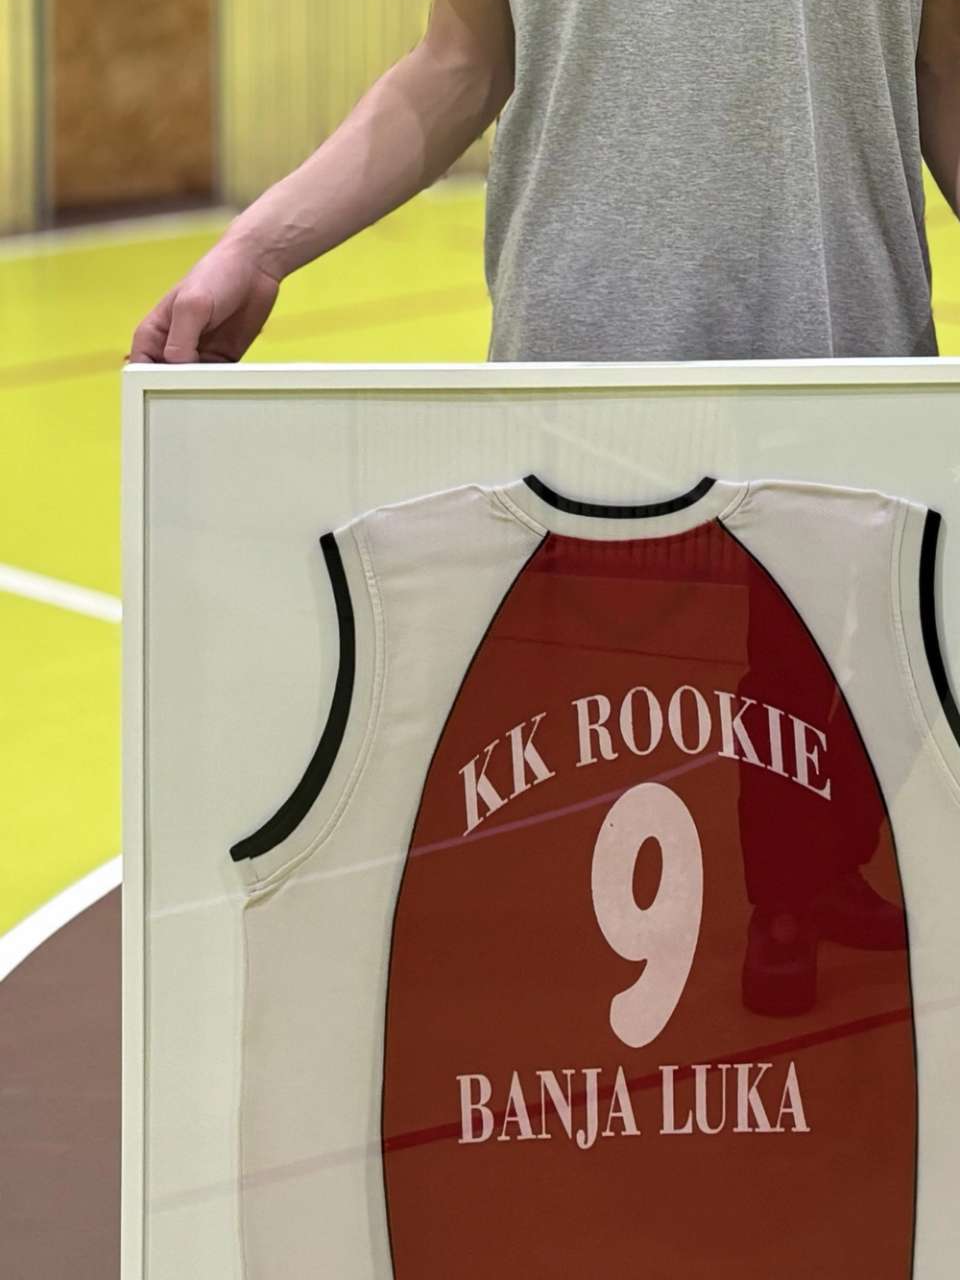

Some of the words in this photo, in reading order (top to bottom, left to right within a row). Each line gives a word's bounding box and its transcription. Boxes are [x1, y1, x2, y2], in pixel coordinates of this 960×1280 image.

[458, 712, 556, 837] KK
[571, 685, 832, 801] ROOKIE
[591, 782, 704, 1048] 9
[456, 1065, 641, 1150] BANJA
[658, 1061, 811, 1135] LUKA
